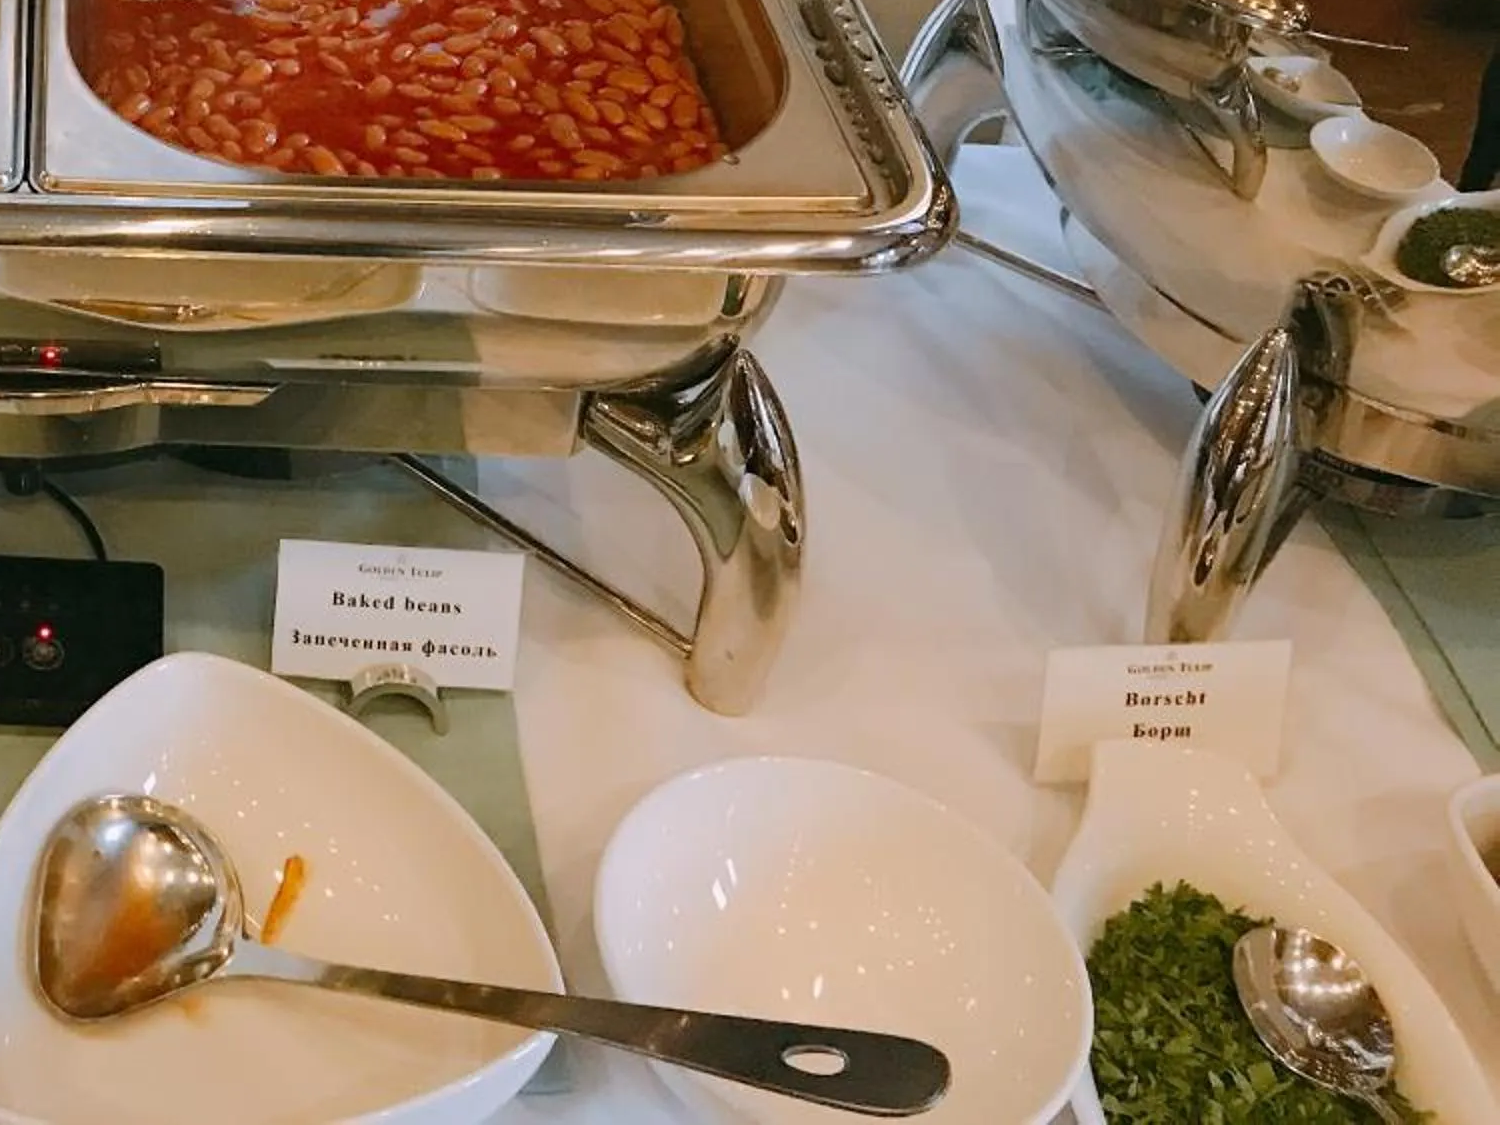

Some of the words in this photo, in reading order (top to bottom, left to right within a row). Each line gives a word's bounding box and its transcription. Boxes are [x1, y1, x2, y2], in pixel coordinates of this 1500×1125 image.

[332, 591, 395, 610] Baked
[405, 596, 462, 614] beans
[292, 629, 412, 652] Запеченная
[421, 639, 497, 657] фасоль
[1125, 690, 1205, 707] Borscht
